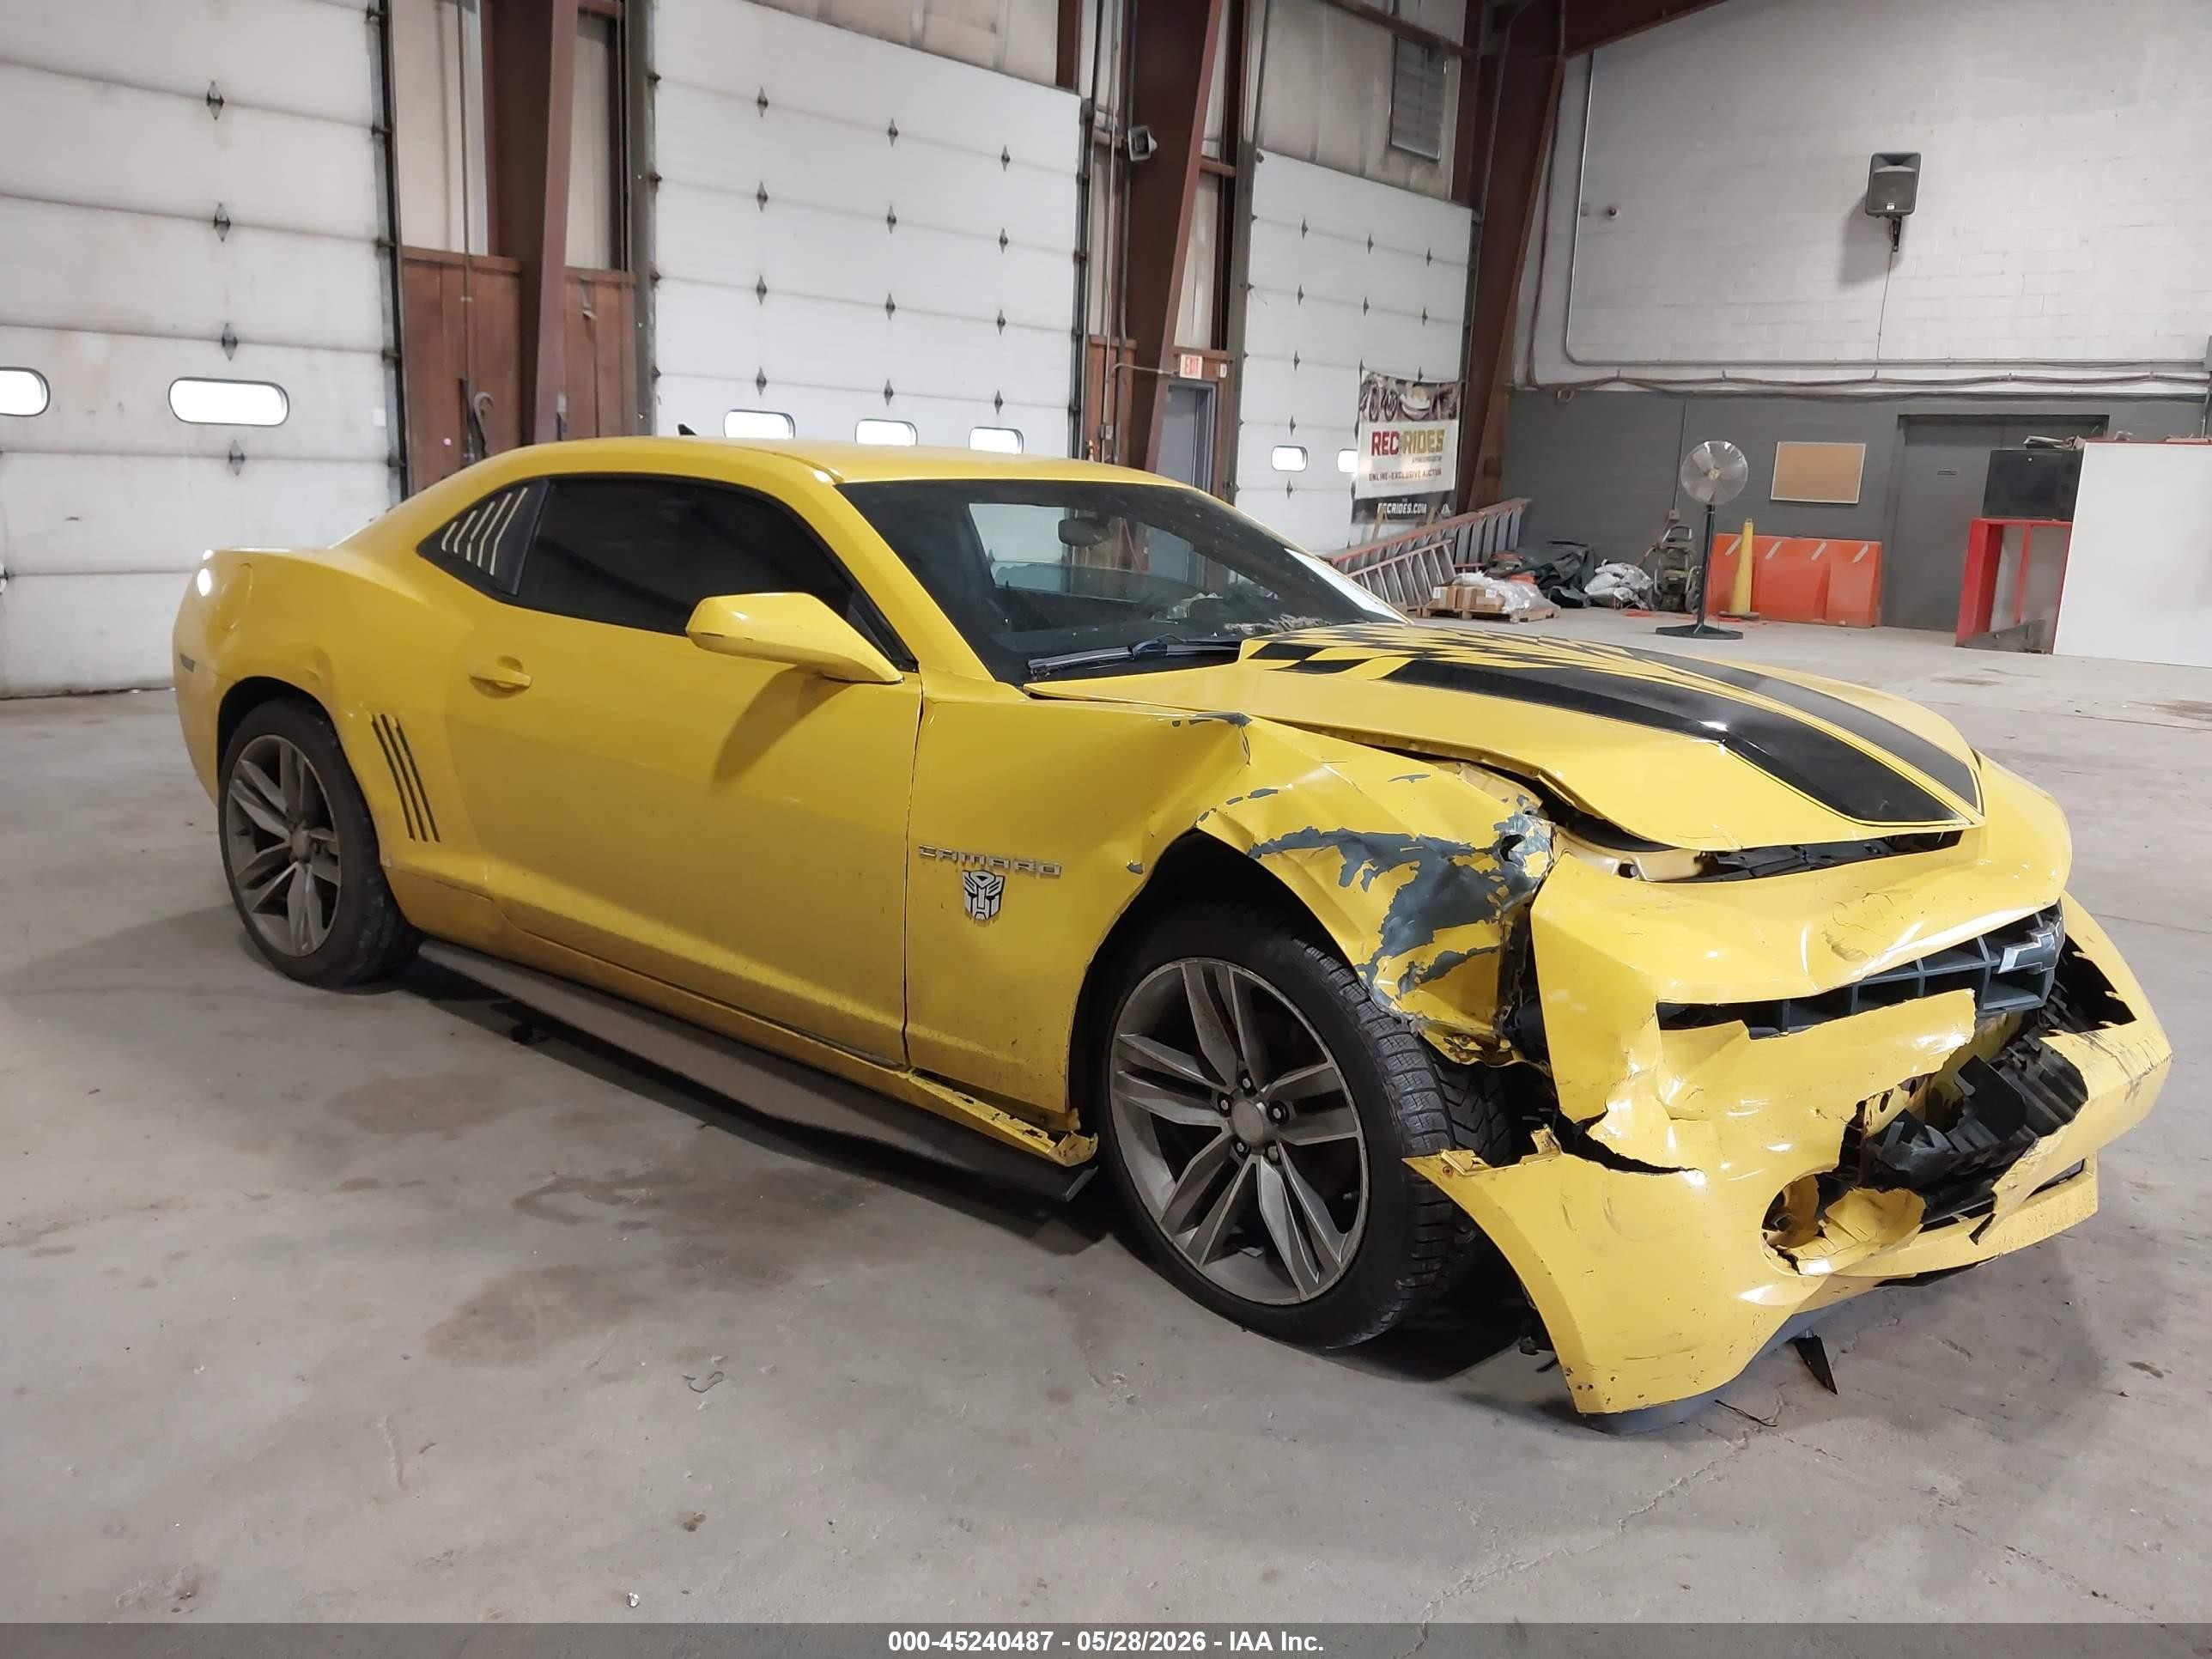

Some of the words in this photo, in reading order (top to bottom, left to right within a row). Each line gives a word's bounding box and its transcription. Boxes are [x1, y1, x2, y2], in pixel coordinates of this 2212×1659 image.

[1371, 431, 1400, 456] REC
[1402, 429, 1445, 453] RIDES
[919, 844, 1062, 876] CAMARO
